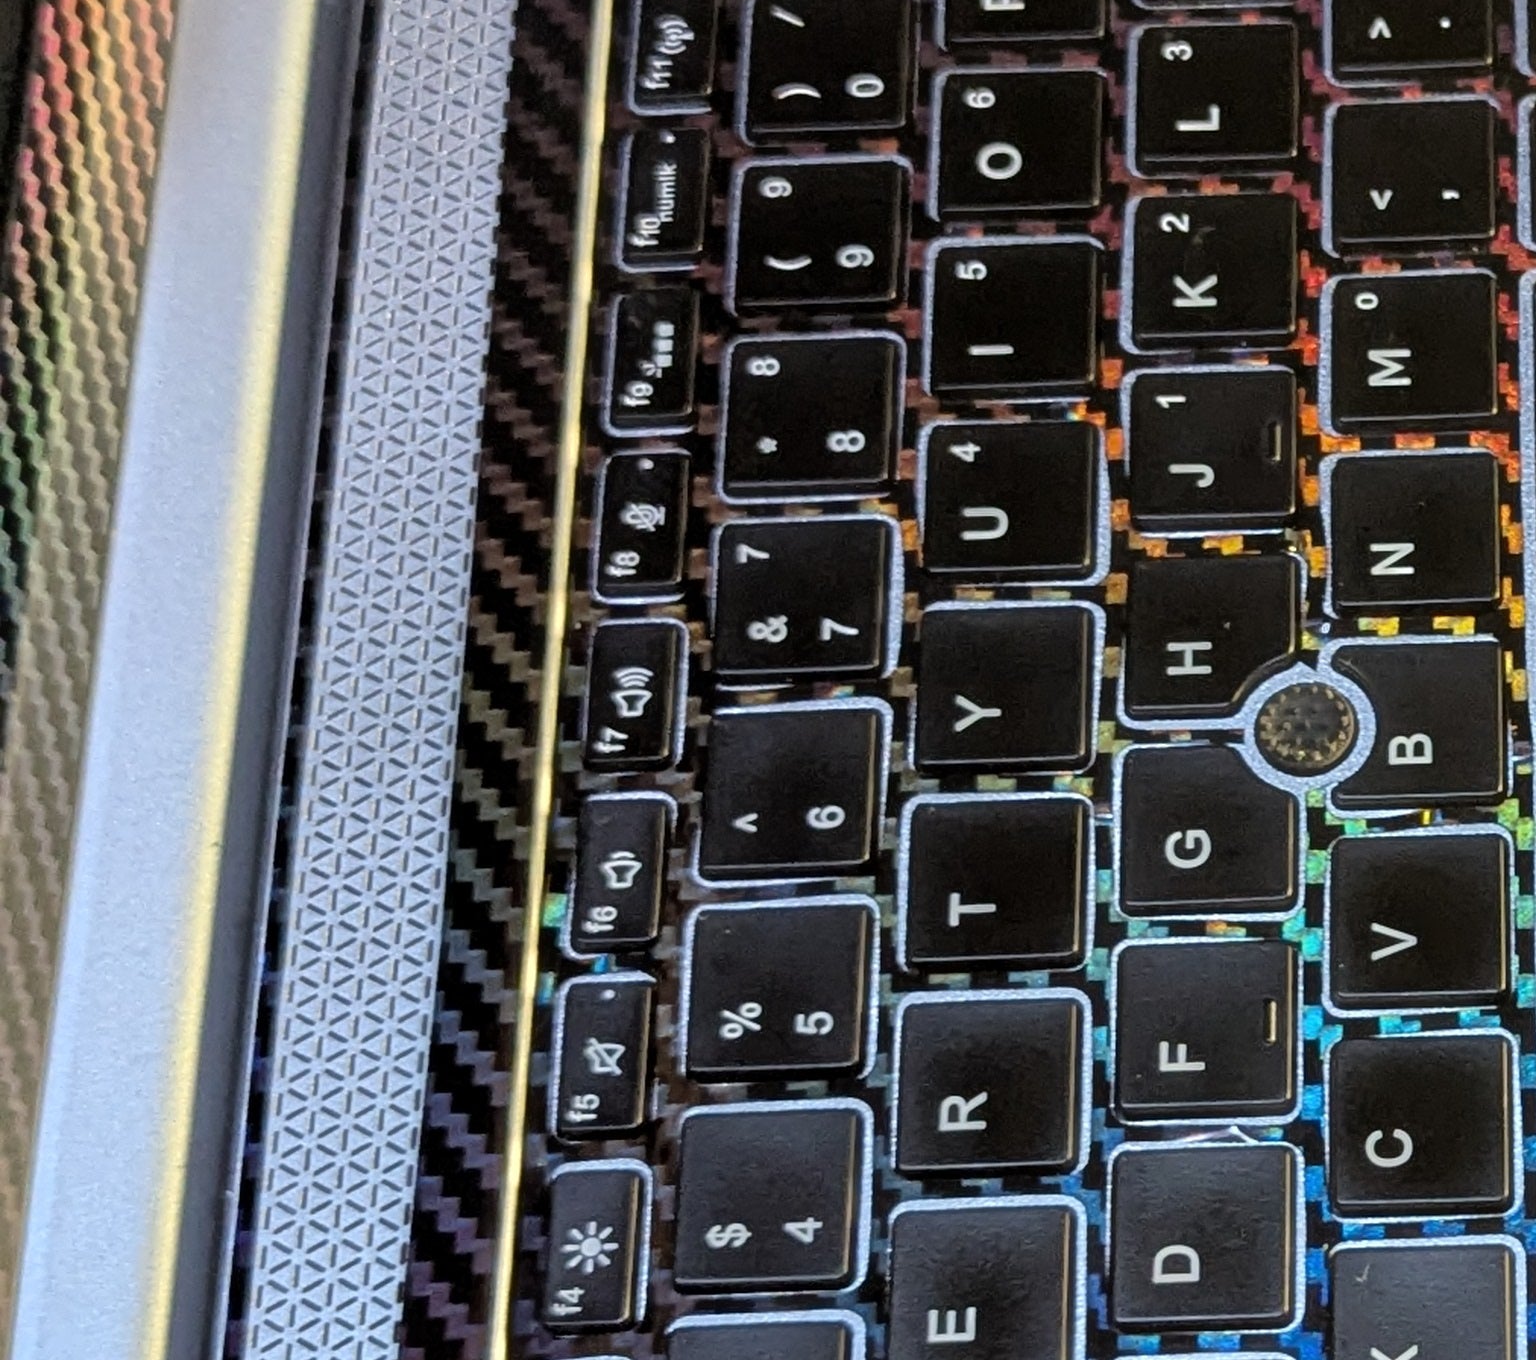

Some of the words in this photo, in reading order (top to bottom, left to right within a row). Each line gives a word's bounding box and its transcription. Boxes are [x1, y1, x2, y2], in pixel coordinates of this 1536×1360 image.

[1161, 40, 1193, 61] 3
[643, 56, 673, 90] f11
[846, 74, 885, 98] 0
[963, 87, 996, 109] 6
[1175, 104, 1221, 132] L
[975, 142, 1023, 180] O
[759, 176, 793, 199] 9
[629, 214, 661, 248] f10
[1159, 213, 1190, 233] 2
[836, 244, 875, 269] 9
[955, 260, 988, 281] 5
[1172, 274, 1218, 308] K
[967, 344, 1015, 356] I
[746, 355, 781, 377] 8
[1367, 348, 1412, 387] M
[620, 380, 654, 408] f9
[1155, 395, 1187, 409] 1
[826, 429, 866, 453] 8
[949, 441, 982, 463] 4
[1168, 463, 1215, 488] J
[960, 506, 1009, 541] U
[605, 550, 641, 578] f8
[736, 543, 770, 564] 7
[1369, 542, 1415, 576] N
[747, 614, 789, 644] &
[820, 617, 860, 641] 7
[1165, 641, 1213, 676] H
[953, 694, 1002, 733] Y
[593, 726, 629, 754] f7
[1387, 732, 1433, 766] B
[805, 804, 846, 830] 6
[1164, 829, 1212, 869] G
[582, 905, 618, 934] f6
[947, 892, 997, 928] T
[1370, 922, 1418, 962] V
[719, 1001, 763, 1040] %
[794, 1010, 834, 1036] 5
[1158, 1040, 1206, 1073] F
[565, 1093, 600, 1123] f5
[937, 1091, 988, 1133] R
[1364, 1128, 1414, 1169] C
[704, 1222, 753, 1249] $
[783, 1216, 824, 1244] 4
[1151, 1244, 1201, 1285] D
[549, 1286, 585, 1316] f4
[925, 1306, 977, 1344] E
